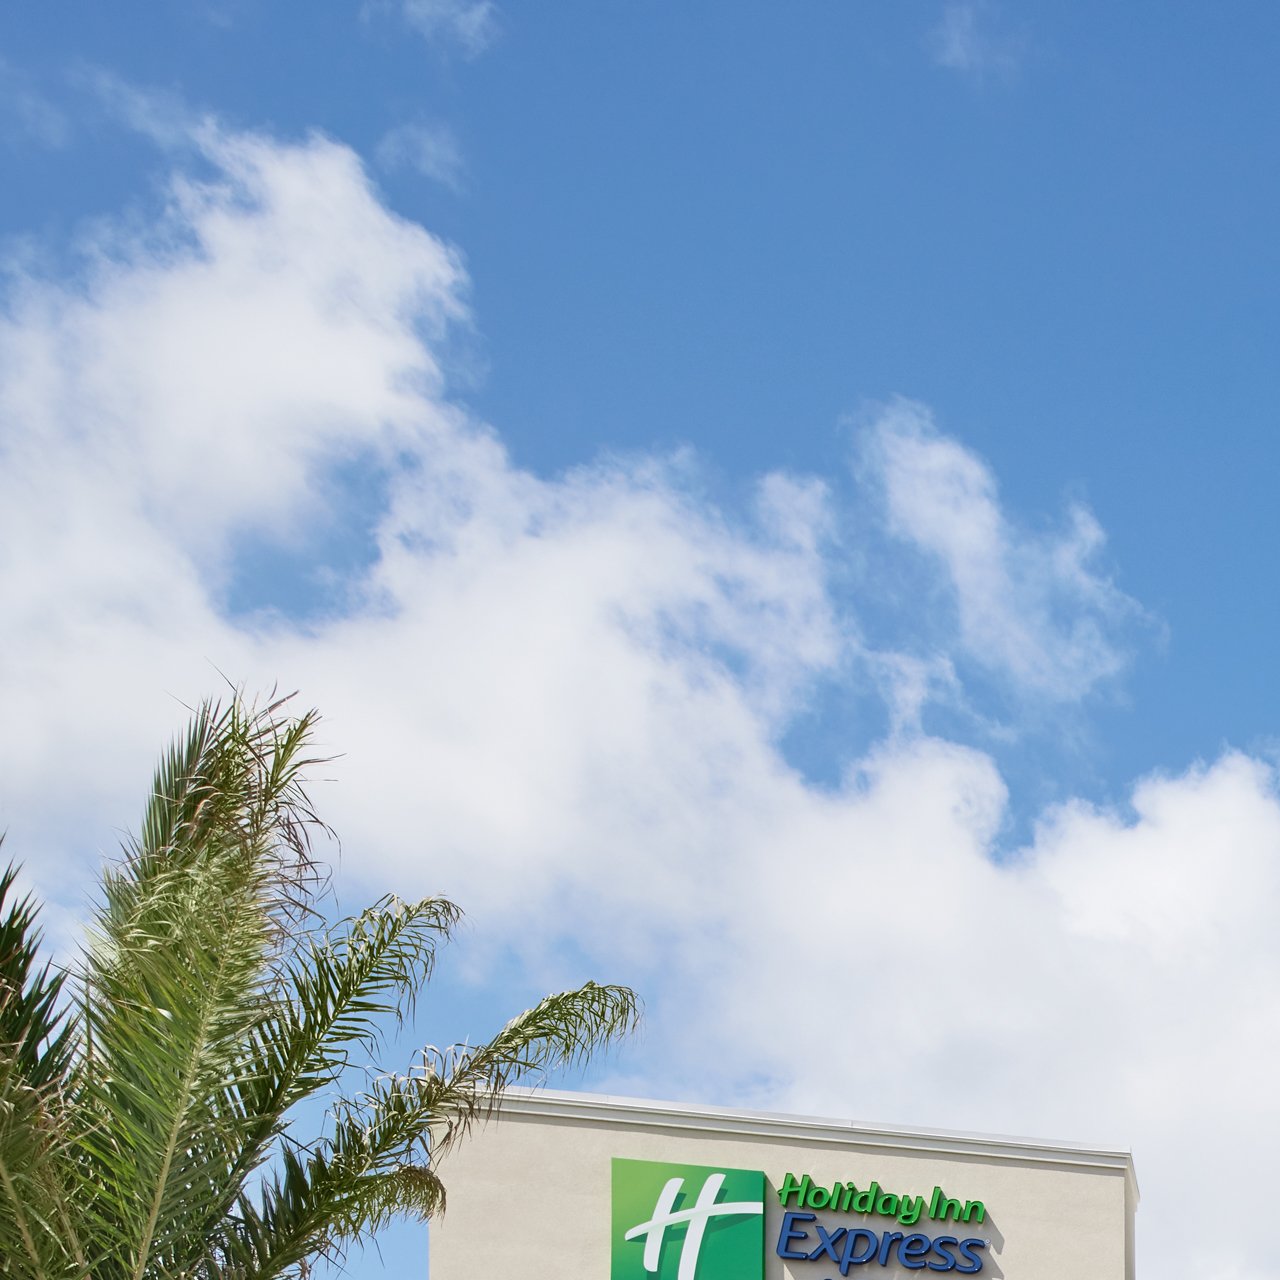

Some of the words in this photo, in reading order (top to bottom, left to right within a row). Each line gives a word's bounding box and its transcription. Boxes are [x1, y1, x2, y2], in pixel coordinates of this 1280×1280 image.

[777, 1172, 923, 1226] Holiday
[928, 1186, 986, 1224] Inn
[776, 1211, 986, 1277] Express
